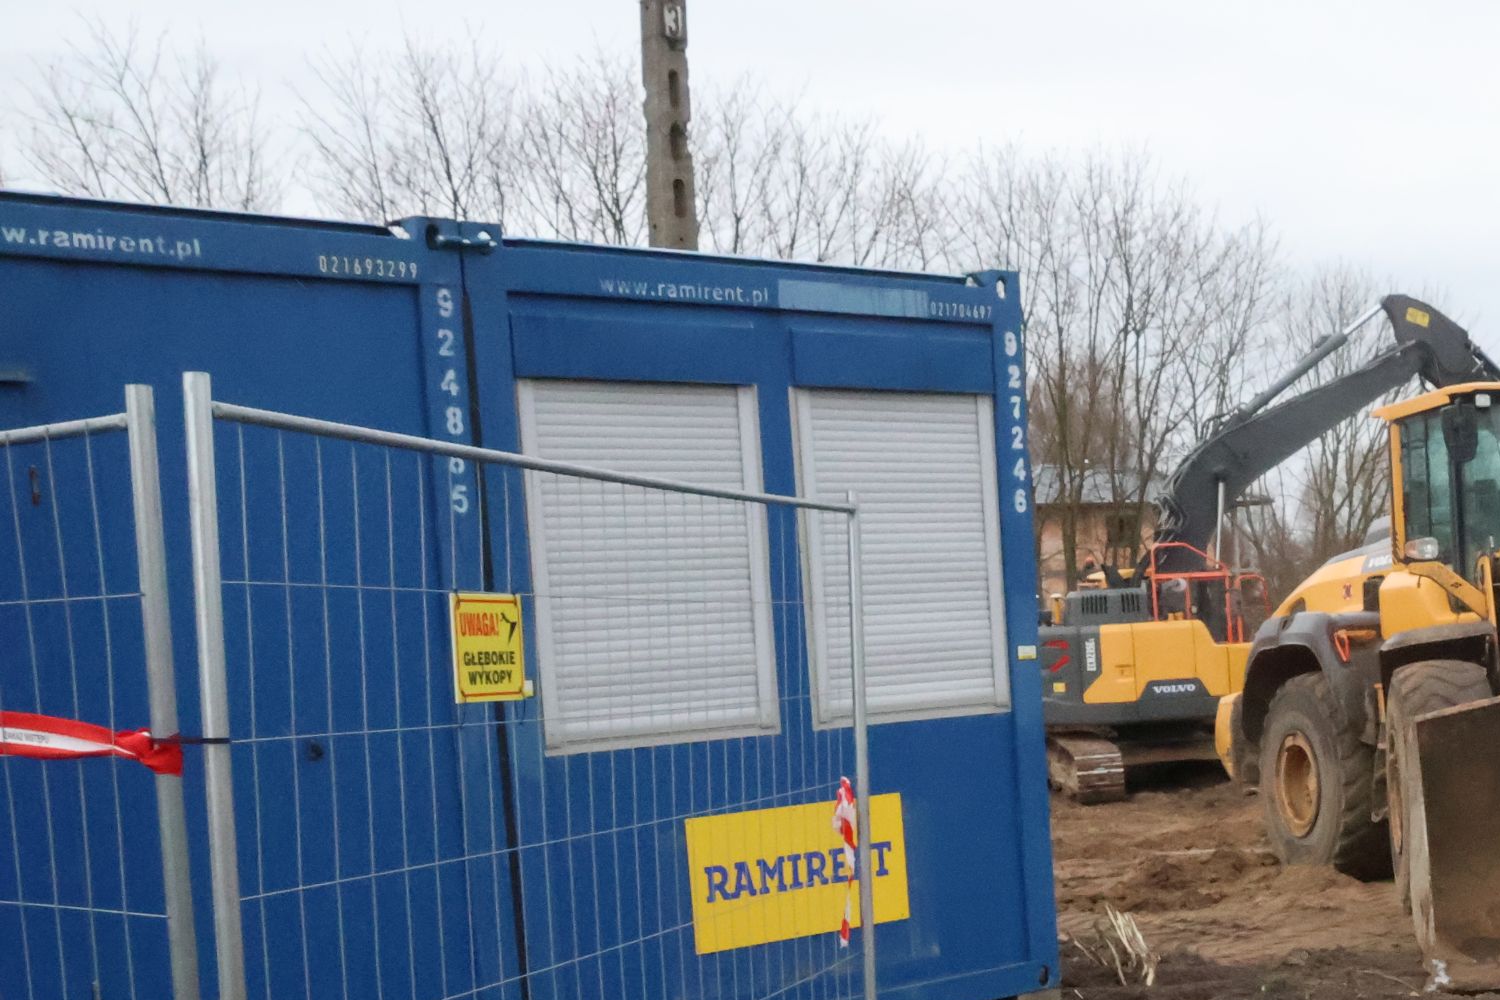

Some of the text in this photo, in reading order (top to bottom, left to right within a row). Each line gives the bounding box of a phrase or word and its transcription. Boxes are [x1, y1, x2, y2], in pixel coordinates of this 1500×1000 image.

[319, 255, 418, 278] 021693299
[600, 279, 768, 307] www.ramirent.pl
[459, 612, 500, 637] UWAGA!
[468, 670, 512, 685] WYKOPY
[1152, 683, 1196, 694] VOLVO
[704, 841, 891, 903] RAMIRET
